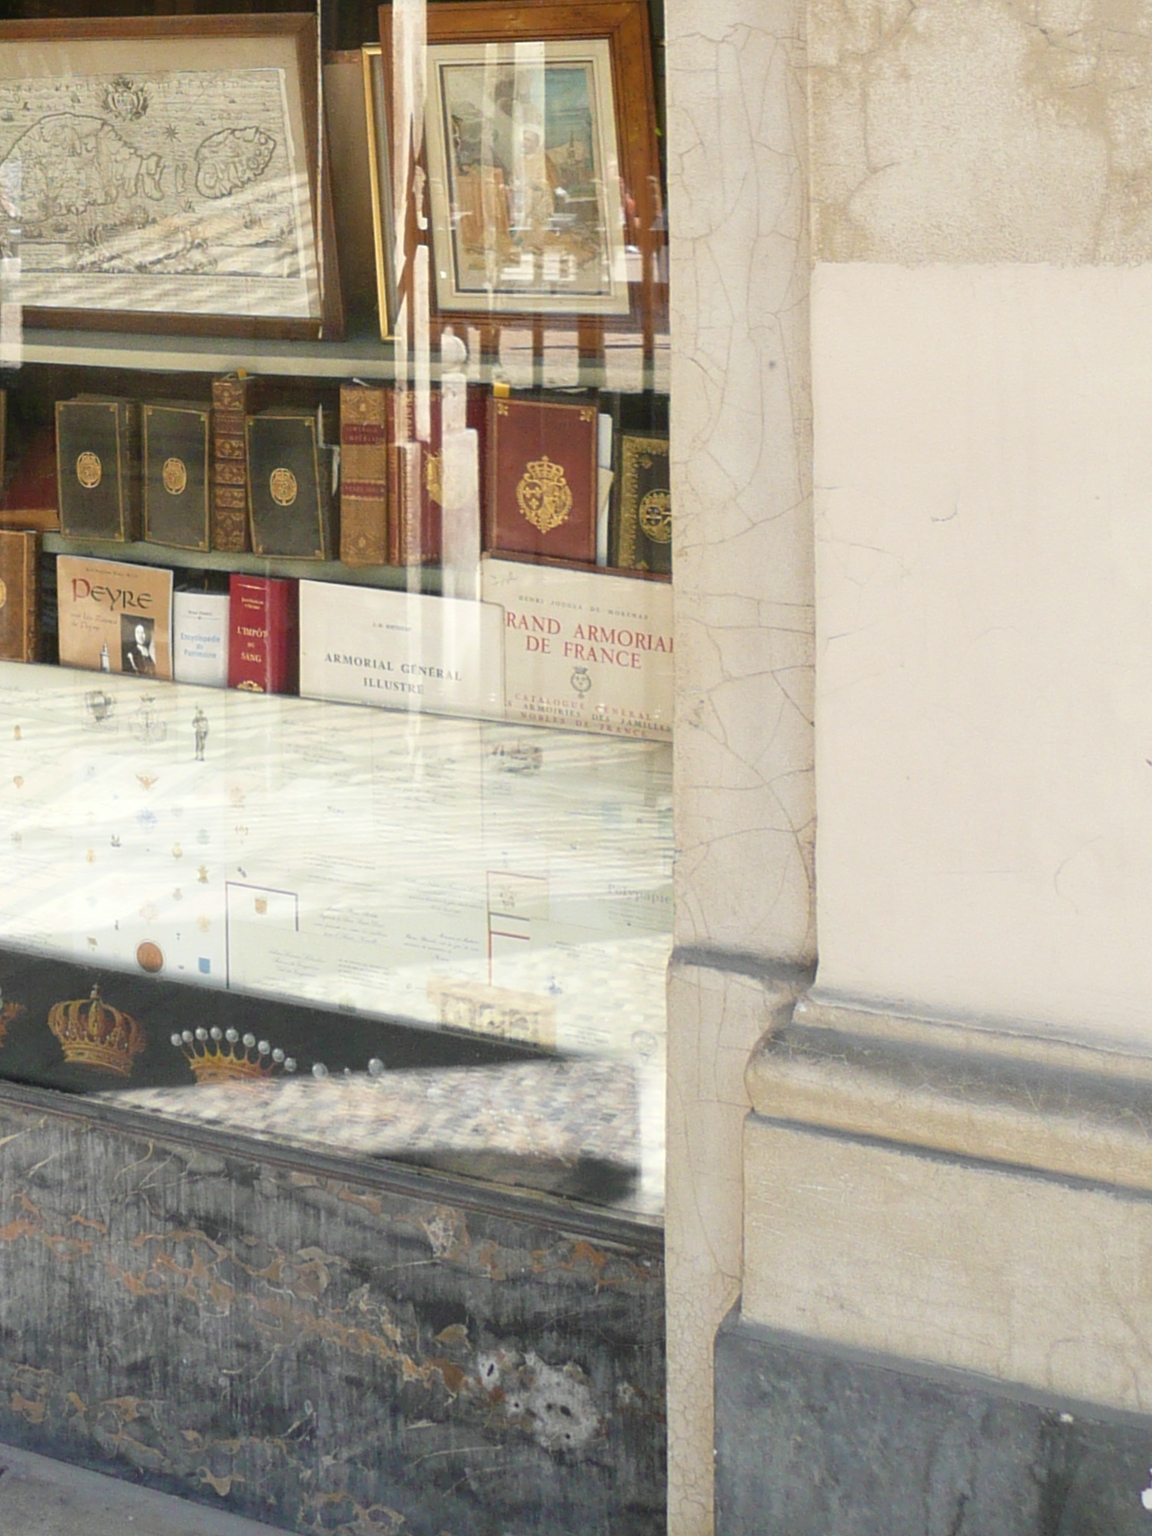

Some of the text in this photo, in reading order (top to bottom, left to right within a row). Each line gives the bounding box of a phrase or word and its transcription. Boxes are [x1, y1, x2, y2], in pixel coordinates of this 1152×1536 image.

[506, 611, 561, 635] RAND
[240, 651, 262, 663] SANG
[324, 652, 394, 672] ARMORIAL
[526, 635, 642, 670] DE FRANCE
[514, 693, 586, 710] CATALOGUE
[522, 703, 581, 718] ARMOIRIES
[592, 713, 610, 722] DES
[520, 711, 648, 738] NOBLES DE FRANCE
